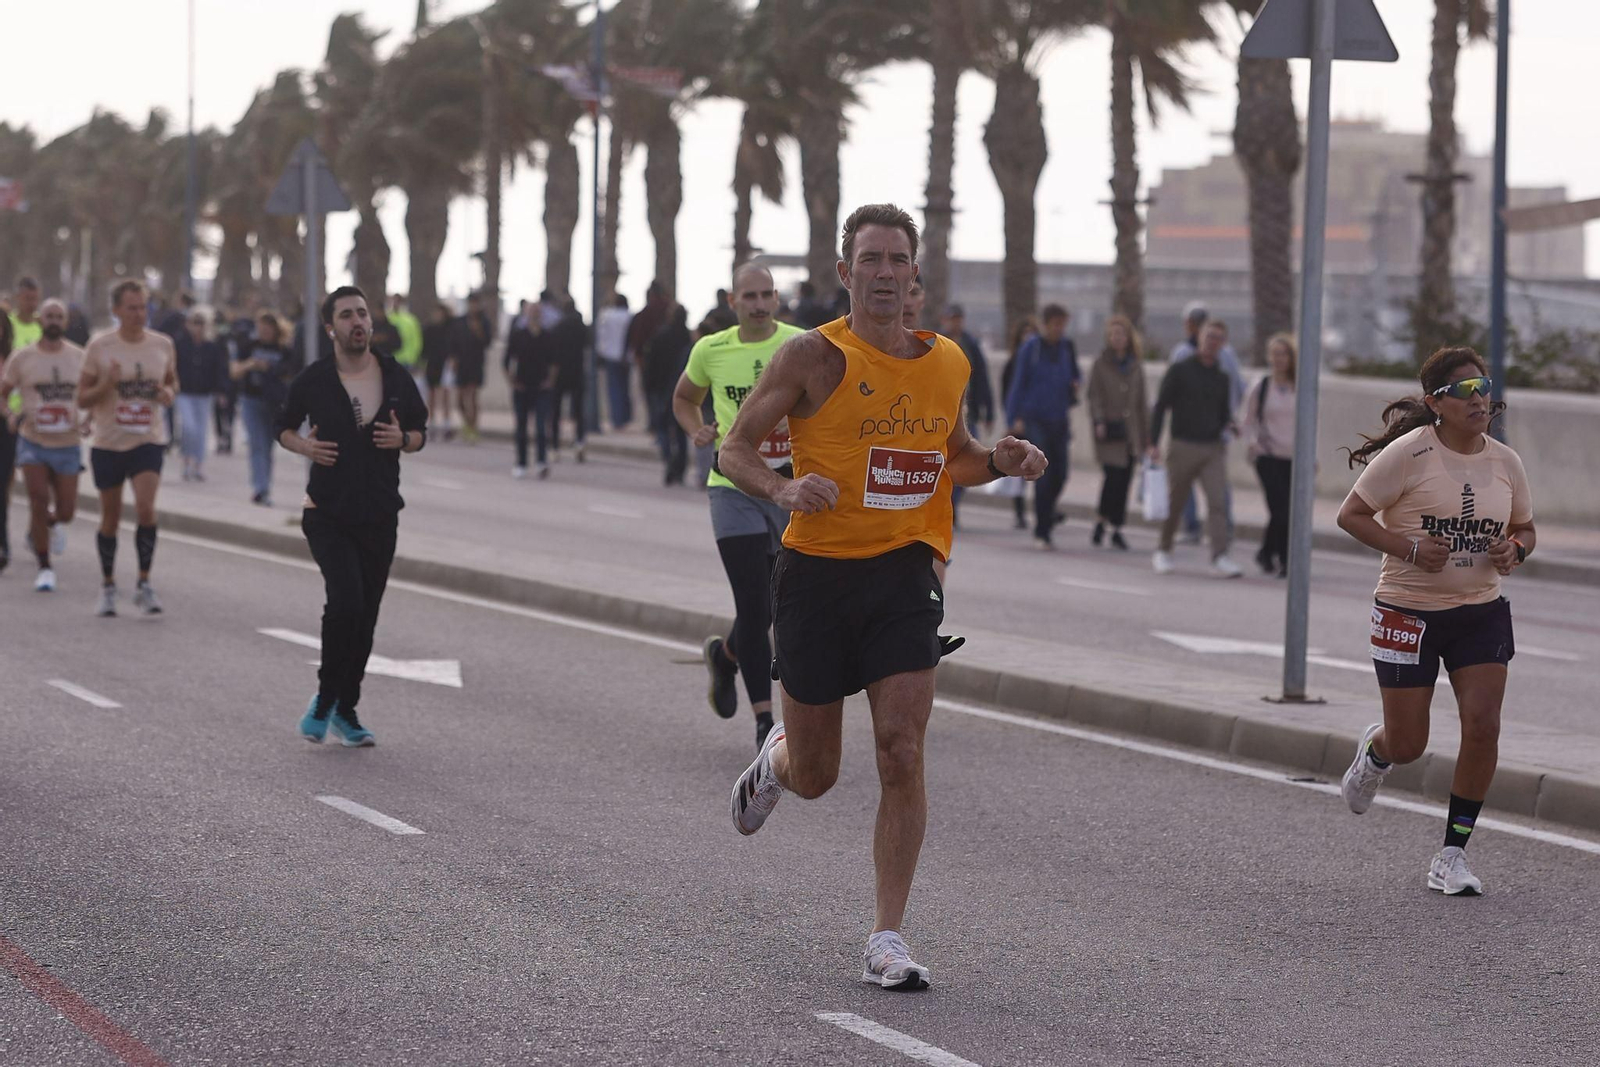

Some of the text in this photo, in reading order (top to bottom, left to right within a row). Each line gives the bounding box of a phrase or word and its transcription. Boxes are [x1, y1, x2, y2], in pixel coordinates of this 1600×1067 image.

[859, 394, 948, 440] parkrun
[871, 466, 905, 479] BRUNCH
[874, 474, 892, 485] RUN
[906, 471, 936, 485] 1536
[1420, 514, 1504, 538] BRUNCH
[1385, 627, 1418, 645] 1599
